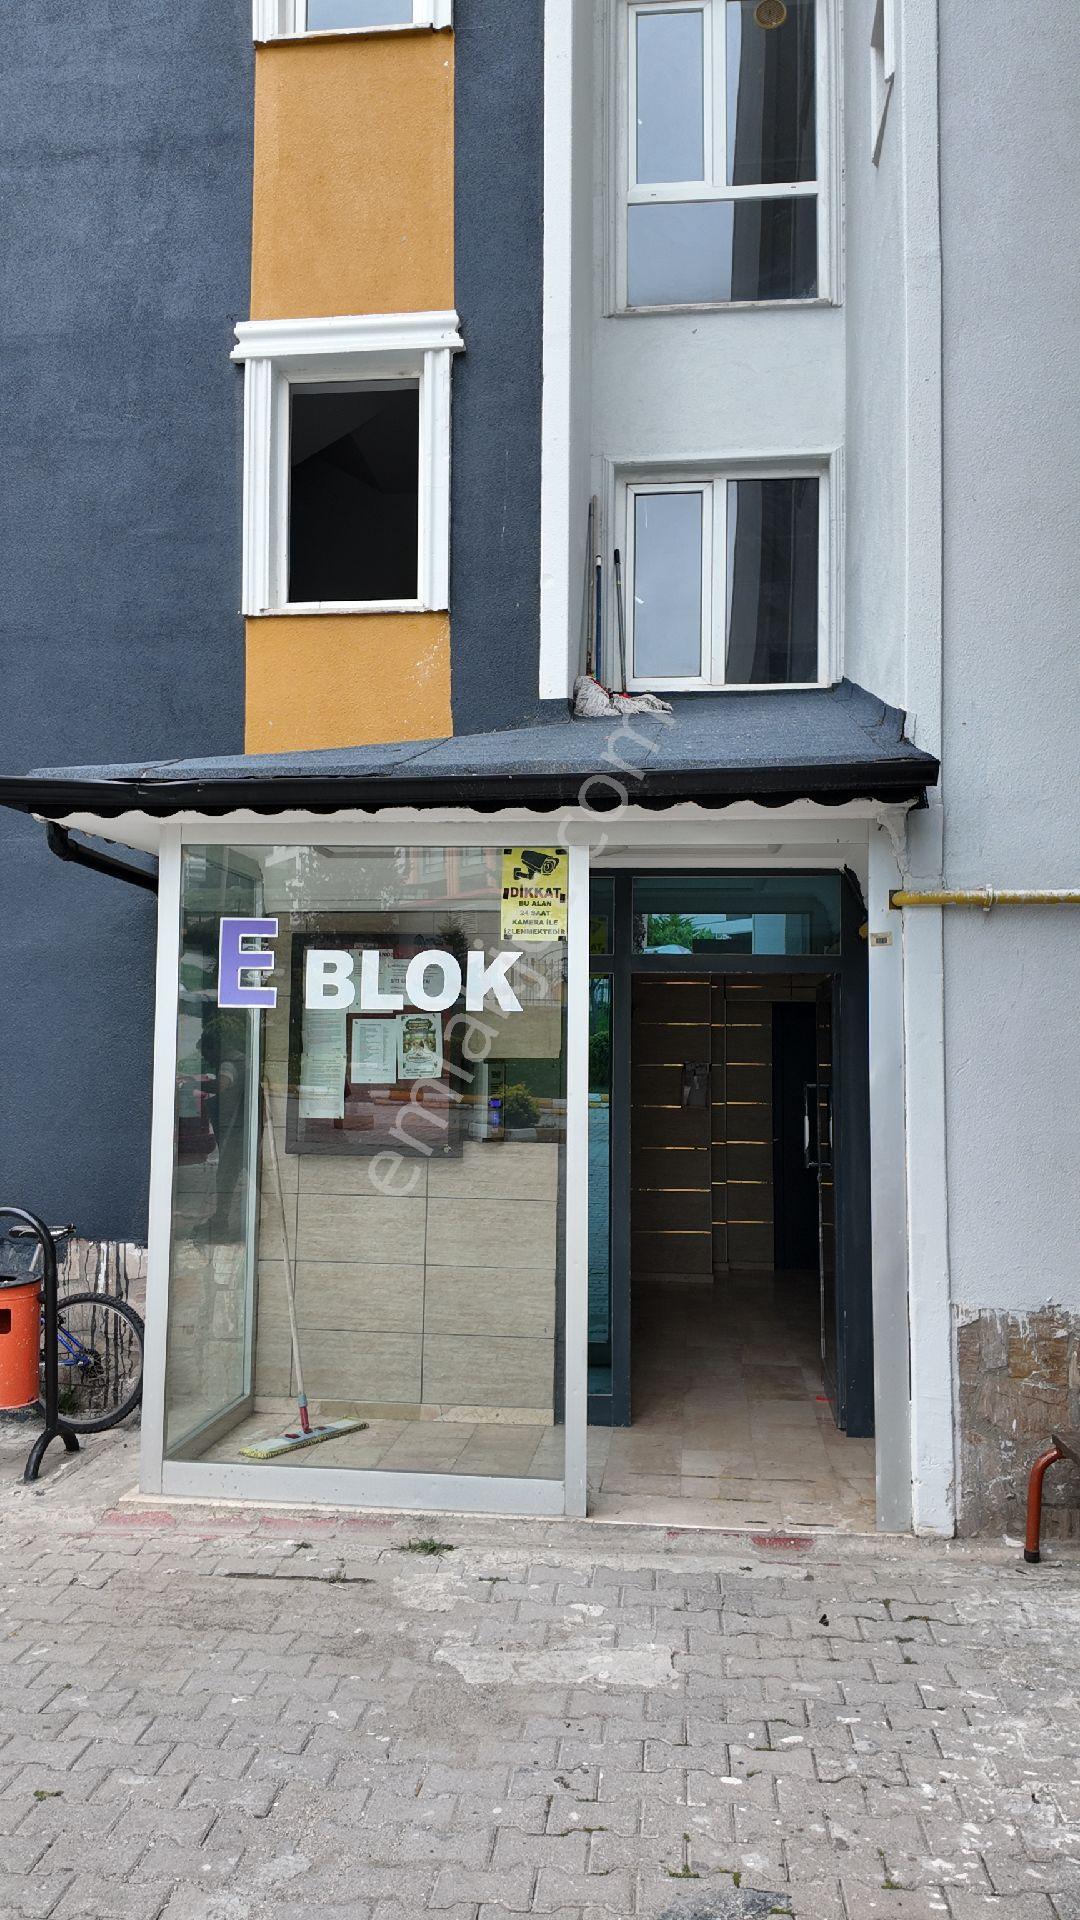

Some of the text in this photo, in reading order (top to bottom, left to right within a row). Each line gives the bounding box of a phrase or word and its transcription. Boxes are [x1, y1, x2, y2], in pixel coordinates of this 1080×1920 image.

[510, 885, 561, 898] DİKKAT
[503, 927, 566, 935] İZLENMEKTEDİR
[217, 917, 524, 1012] E BLOK
